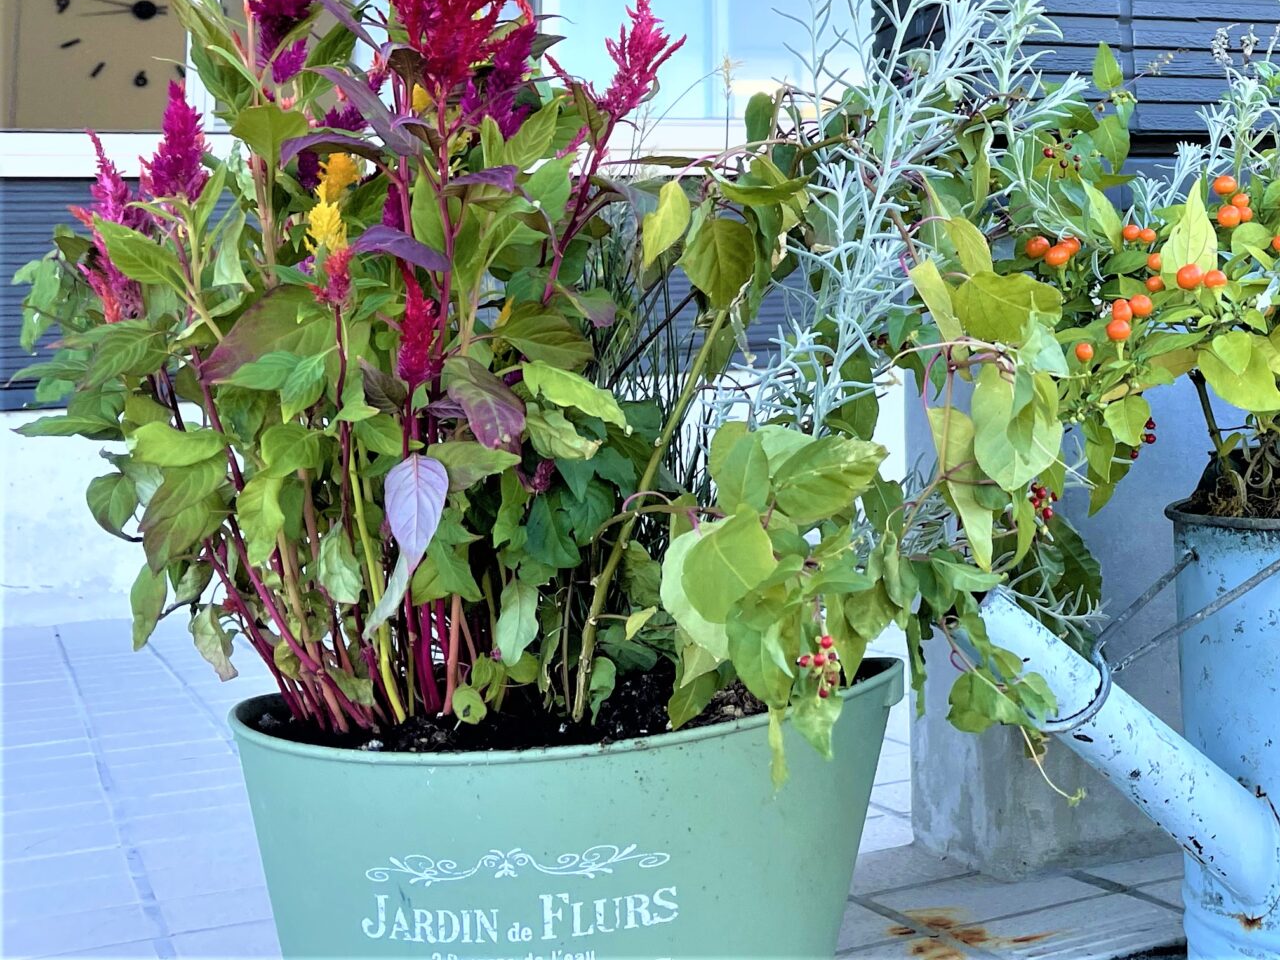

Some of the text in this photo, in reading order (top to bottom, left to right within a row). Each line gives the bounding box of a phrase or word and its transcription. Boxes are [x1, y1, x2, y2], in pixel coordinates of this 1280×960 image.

[134, 71, 148, 88] 6
[361, 886, 679, 944] JARDIN de FLURS
